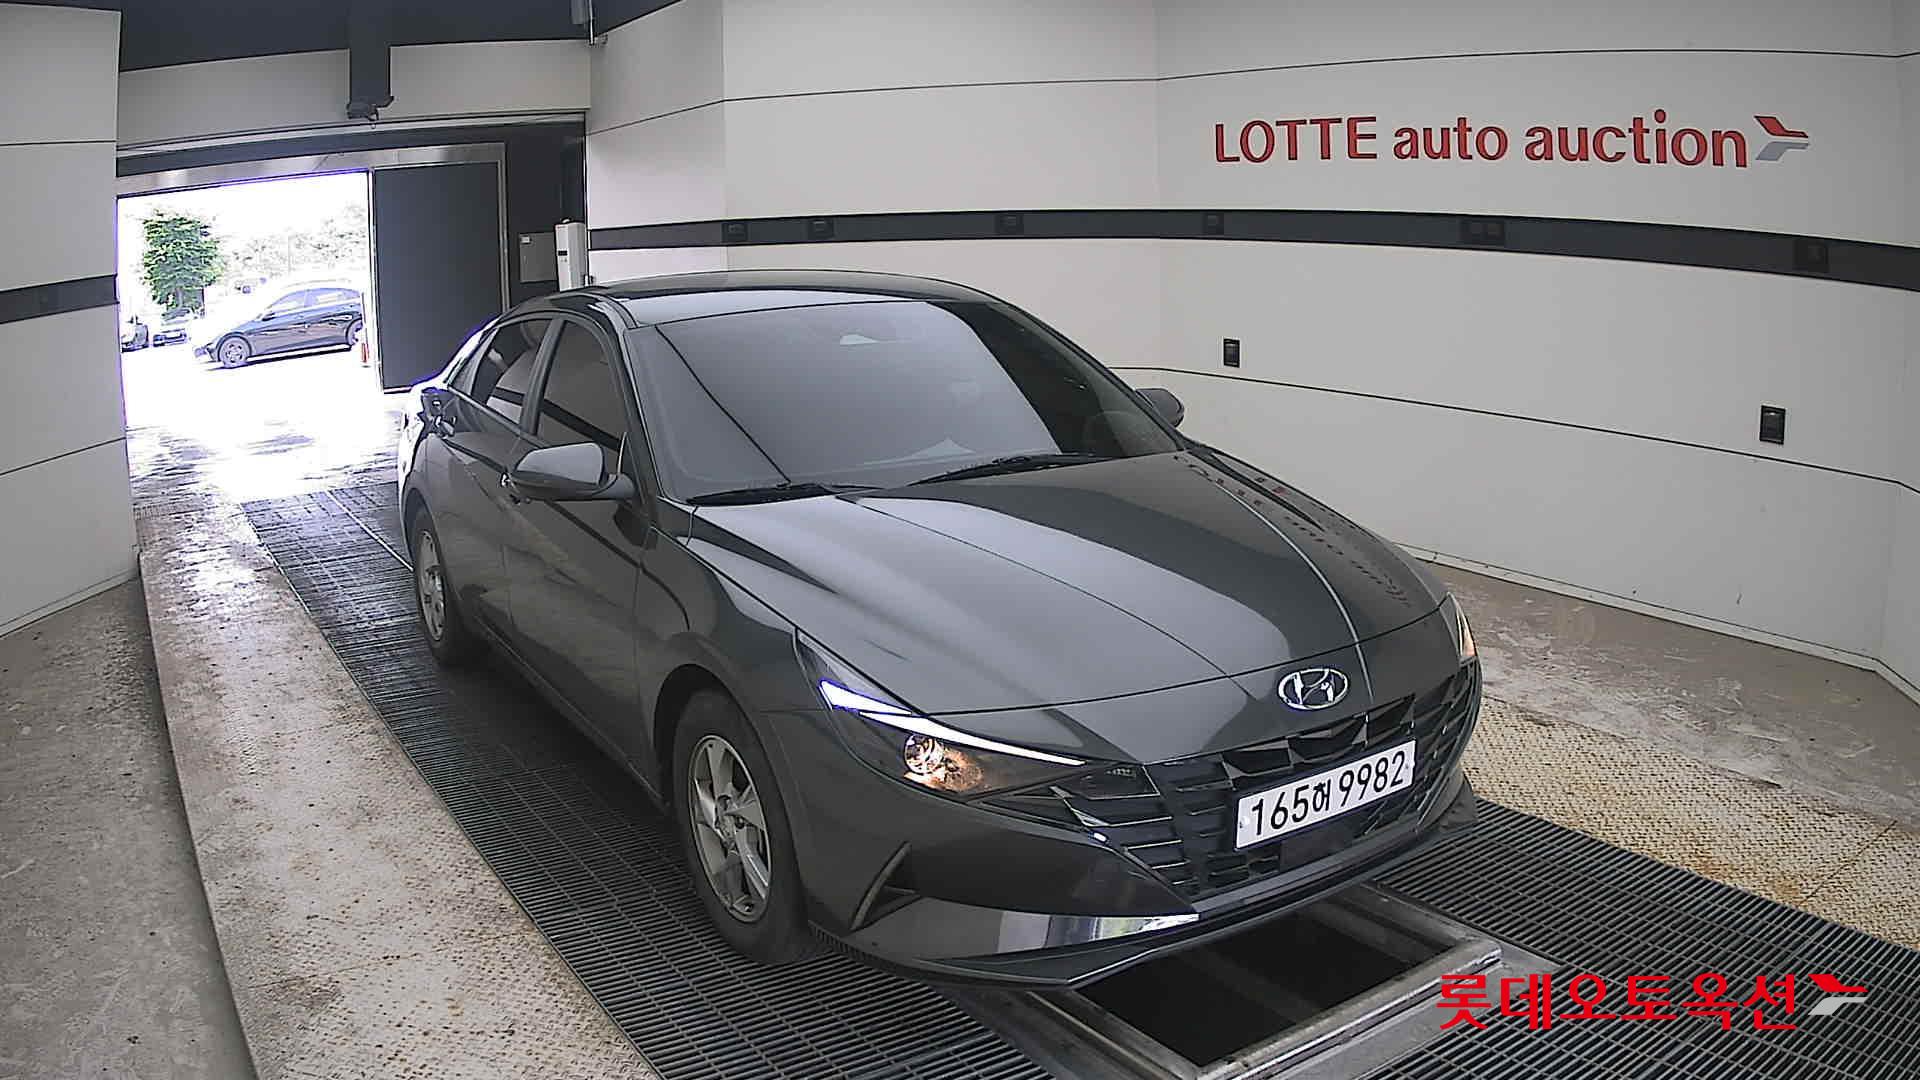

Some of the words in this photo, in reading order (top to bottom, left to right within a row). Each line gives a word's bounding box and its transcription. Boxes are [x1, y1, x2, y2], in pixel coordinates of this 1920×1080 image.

[1215, 116, 1377, 163] LOTTE
[1393, 116, 1509, 161] auto
[1524, 109, 1748, 168] auction
[1338, 750, 1406, 807] 9982
